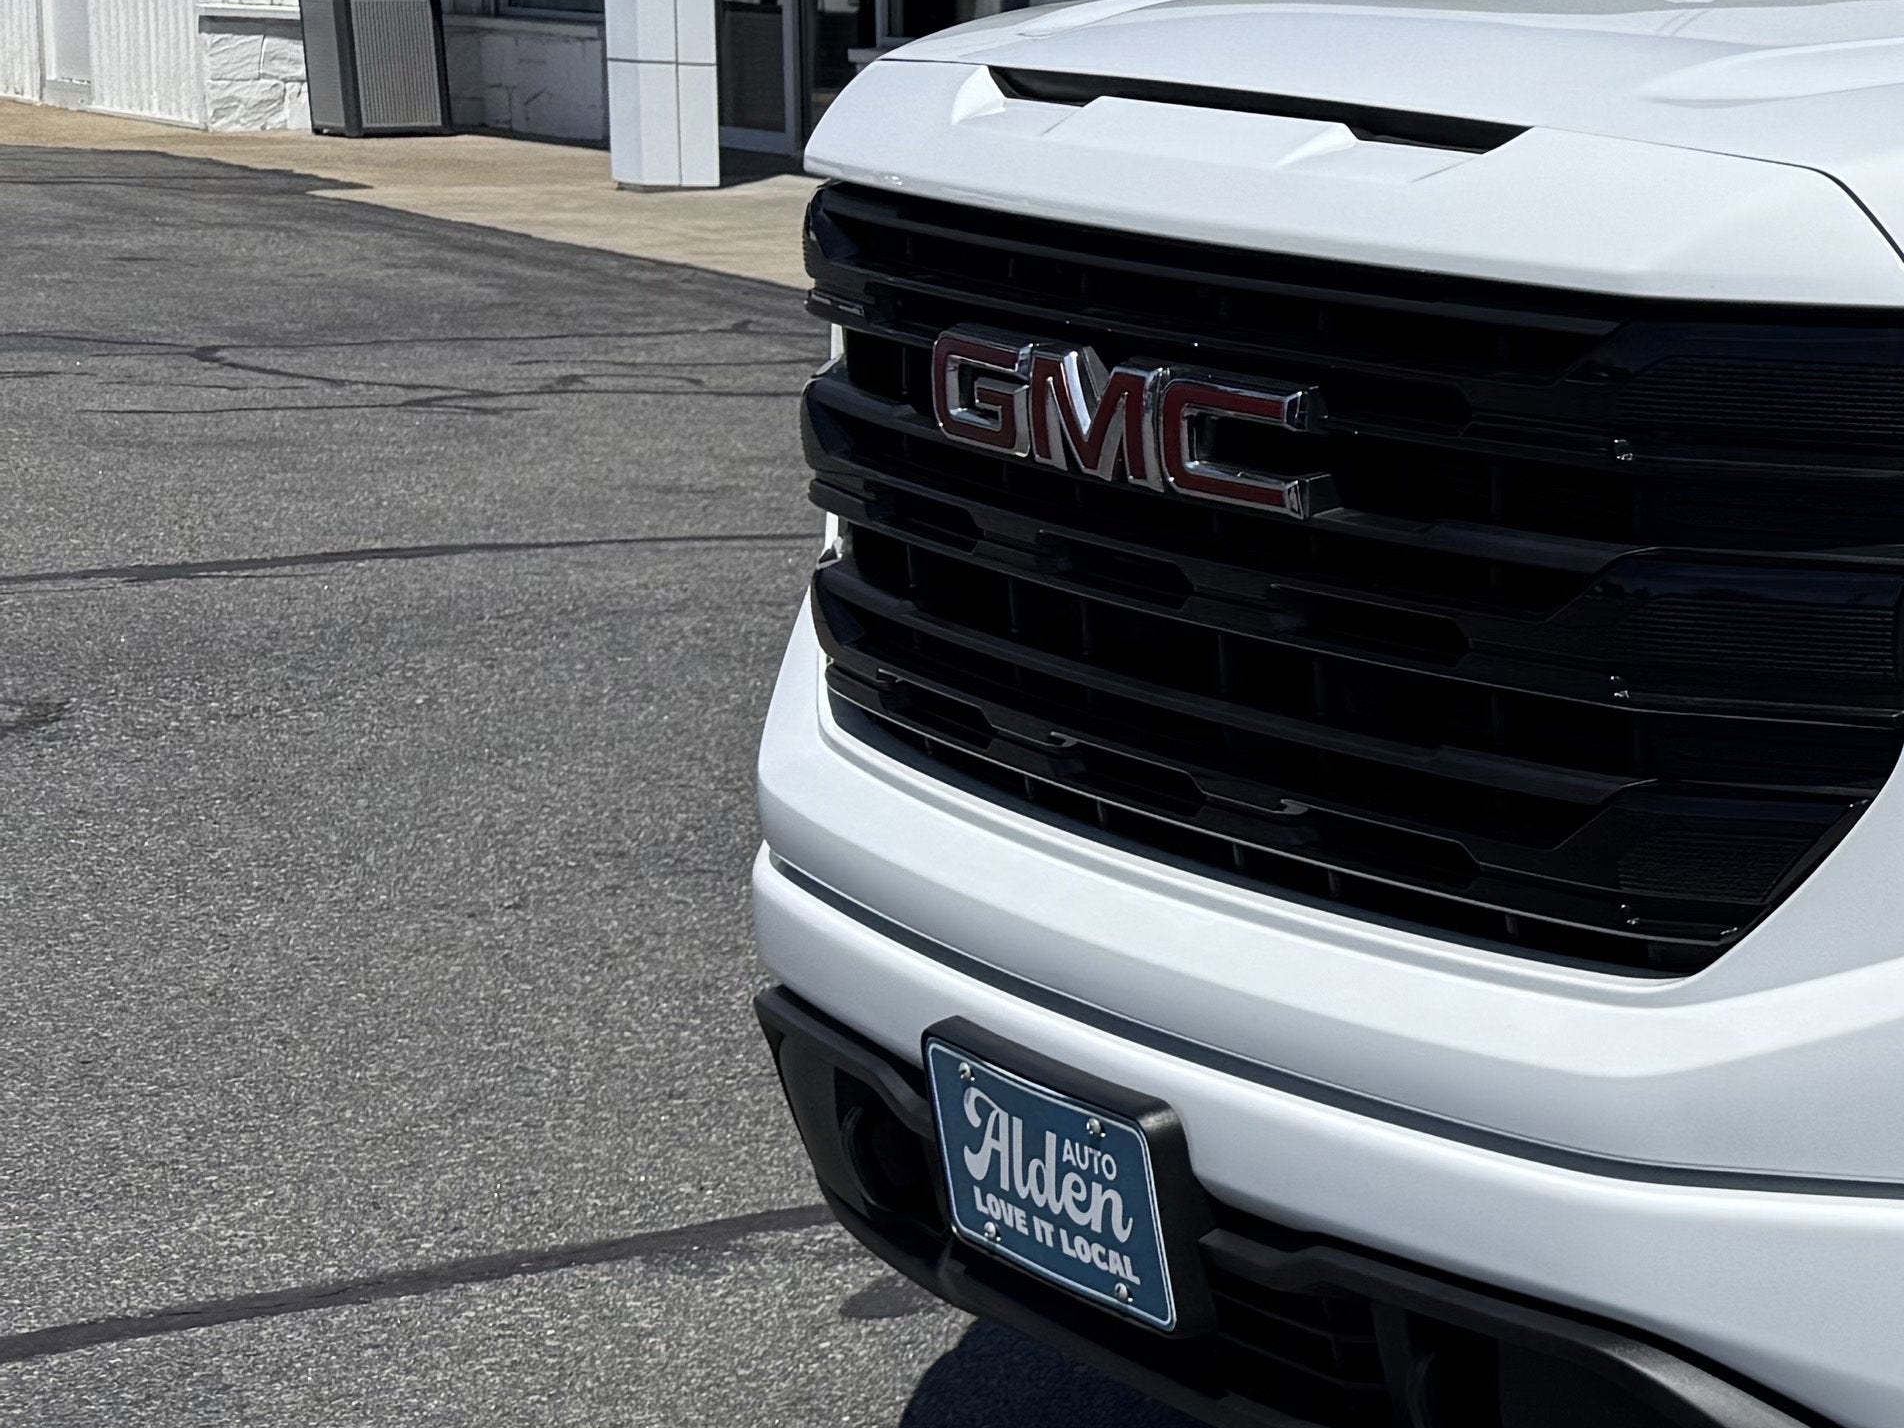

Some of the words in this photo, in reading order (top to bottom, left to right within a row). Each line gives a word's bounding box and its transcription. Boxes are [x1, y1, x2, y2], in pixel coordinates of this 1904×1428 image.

[932, 324, 1330, 520] GMC
[963, 1086, 1134, 1244] Alden
[1062, 1138, 1118, 1181] AUTO
[972, 1185, 1030, 1237] LOVE
[1033, 1215, 1055, 1249] IT
[1059, 1229, 1142, 1286] LOCAL
